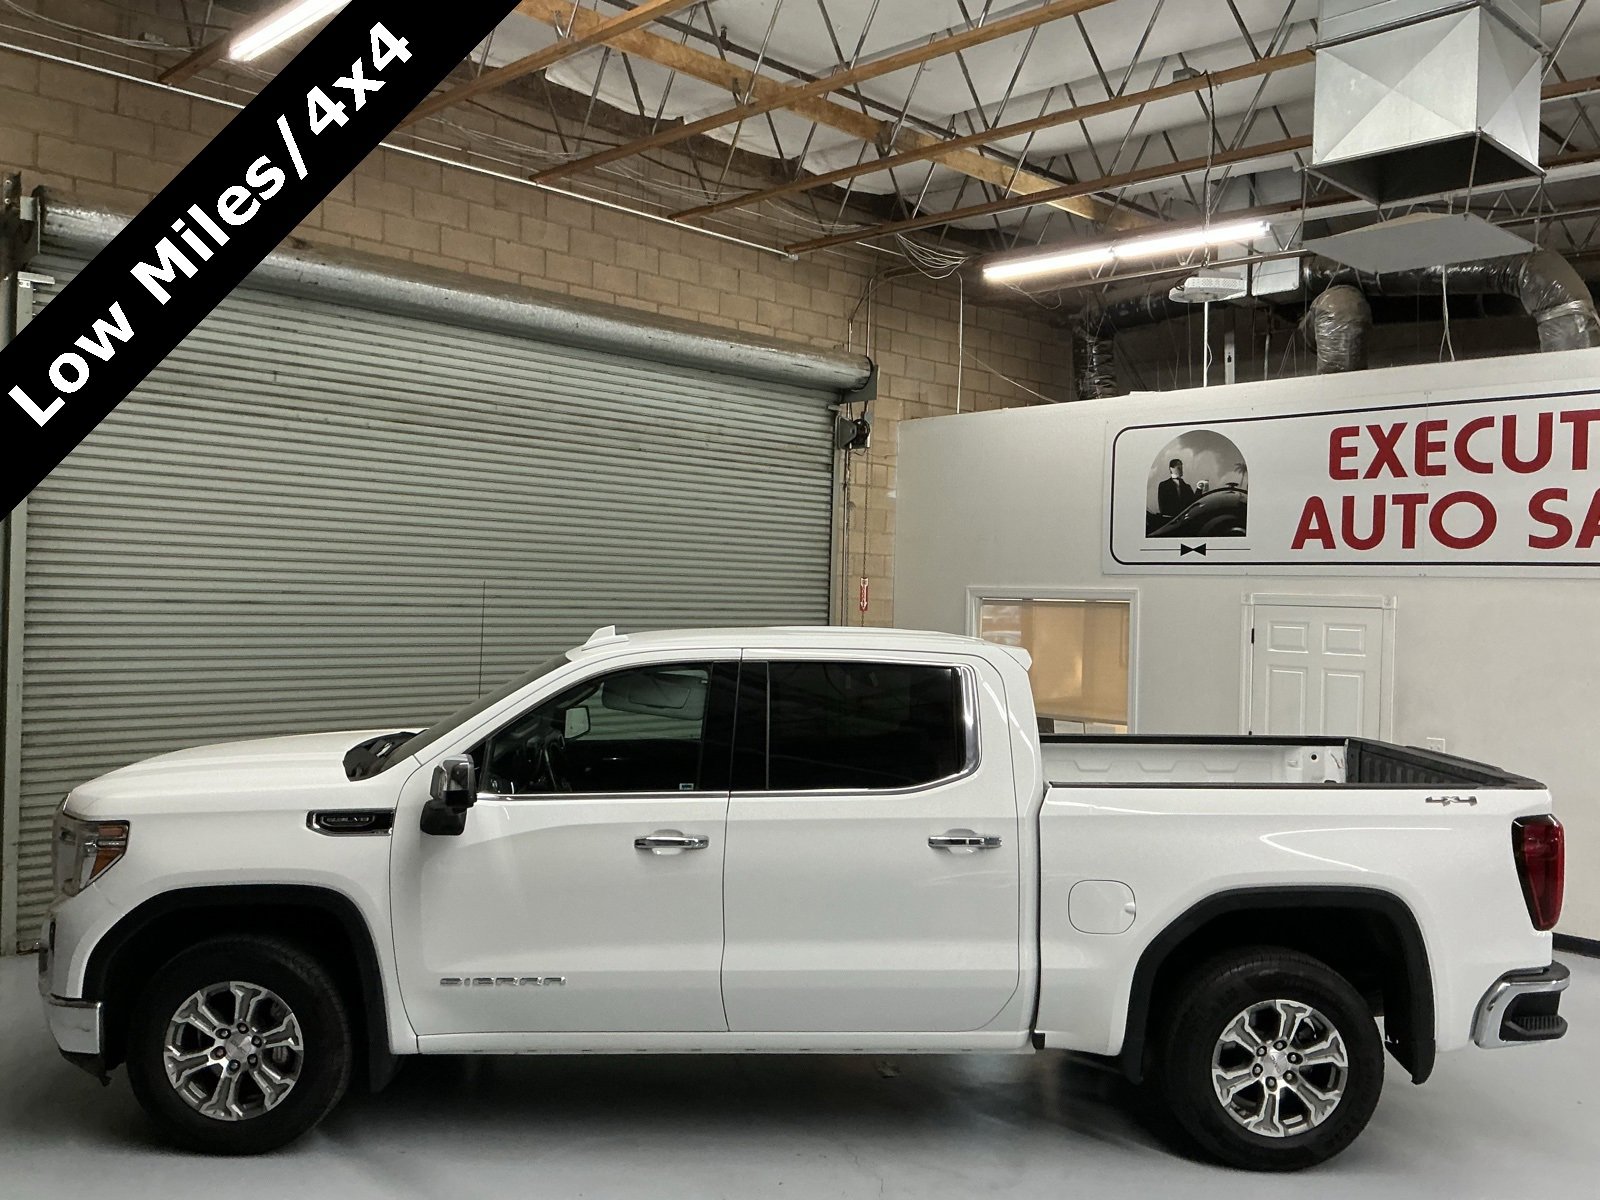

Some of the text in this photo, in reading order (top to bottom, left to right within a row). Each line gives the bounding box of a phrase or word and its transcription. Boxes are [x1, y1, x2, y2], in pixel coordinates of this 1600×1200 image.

[1328, 409, 1600, 481] EXECUT
[1290, 490, 1498, 551] AUTO
[439, 976, 567, 987] SIERRA
